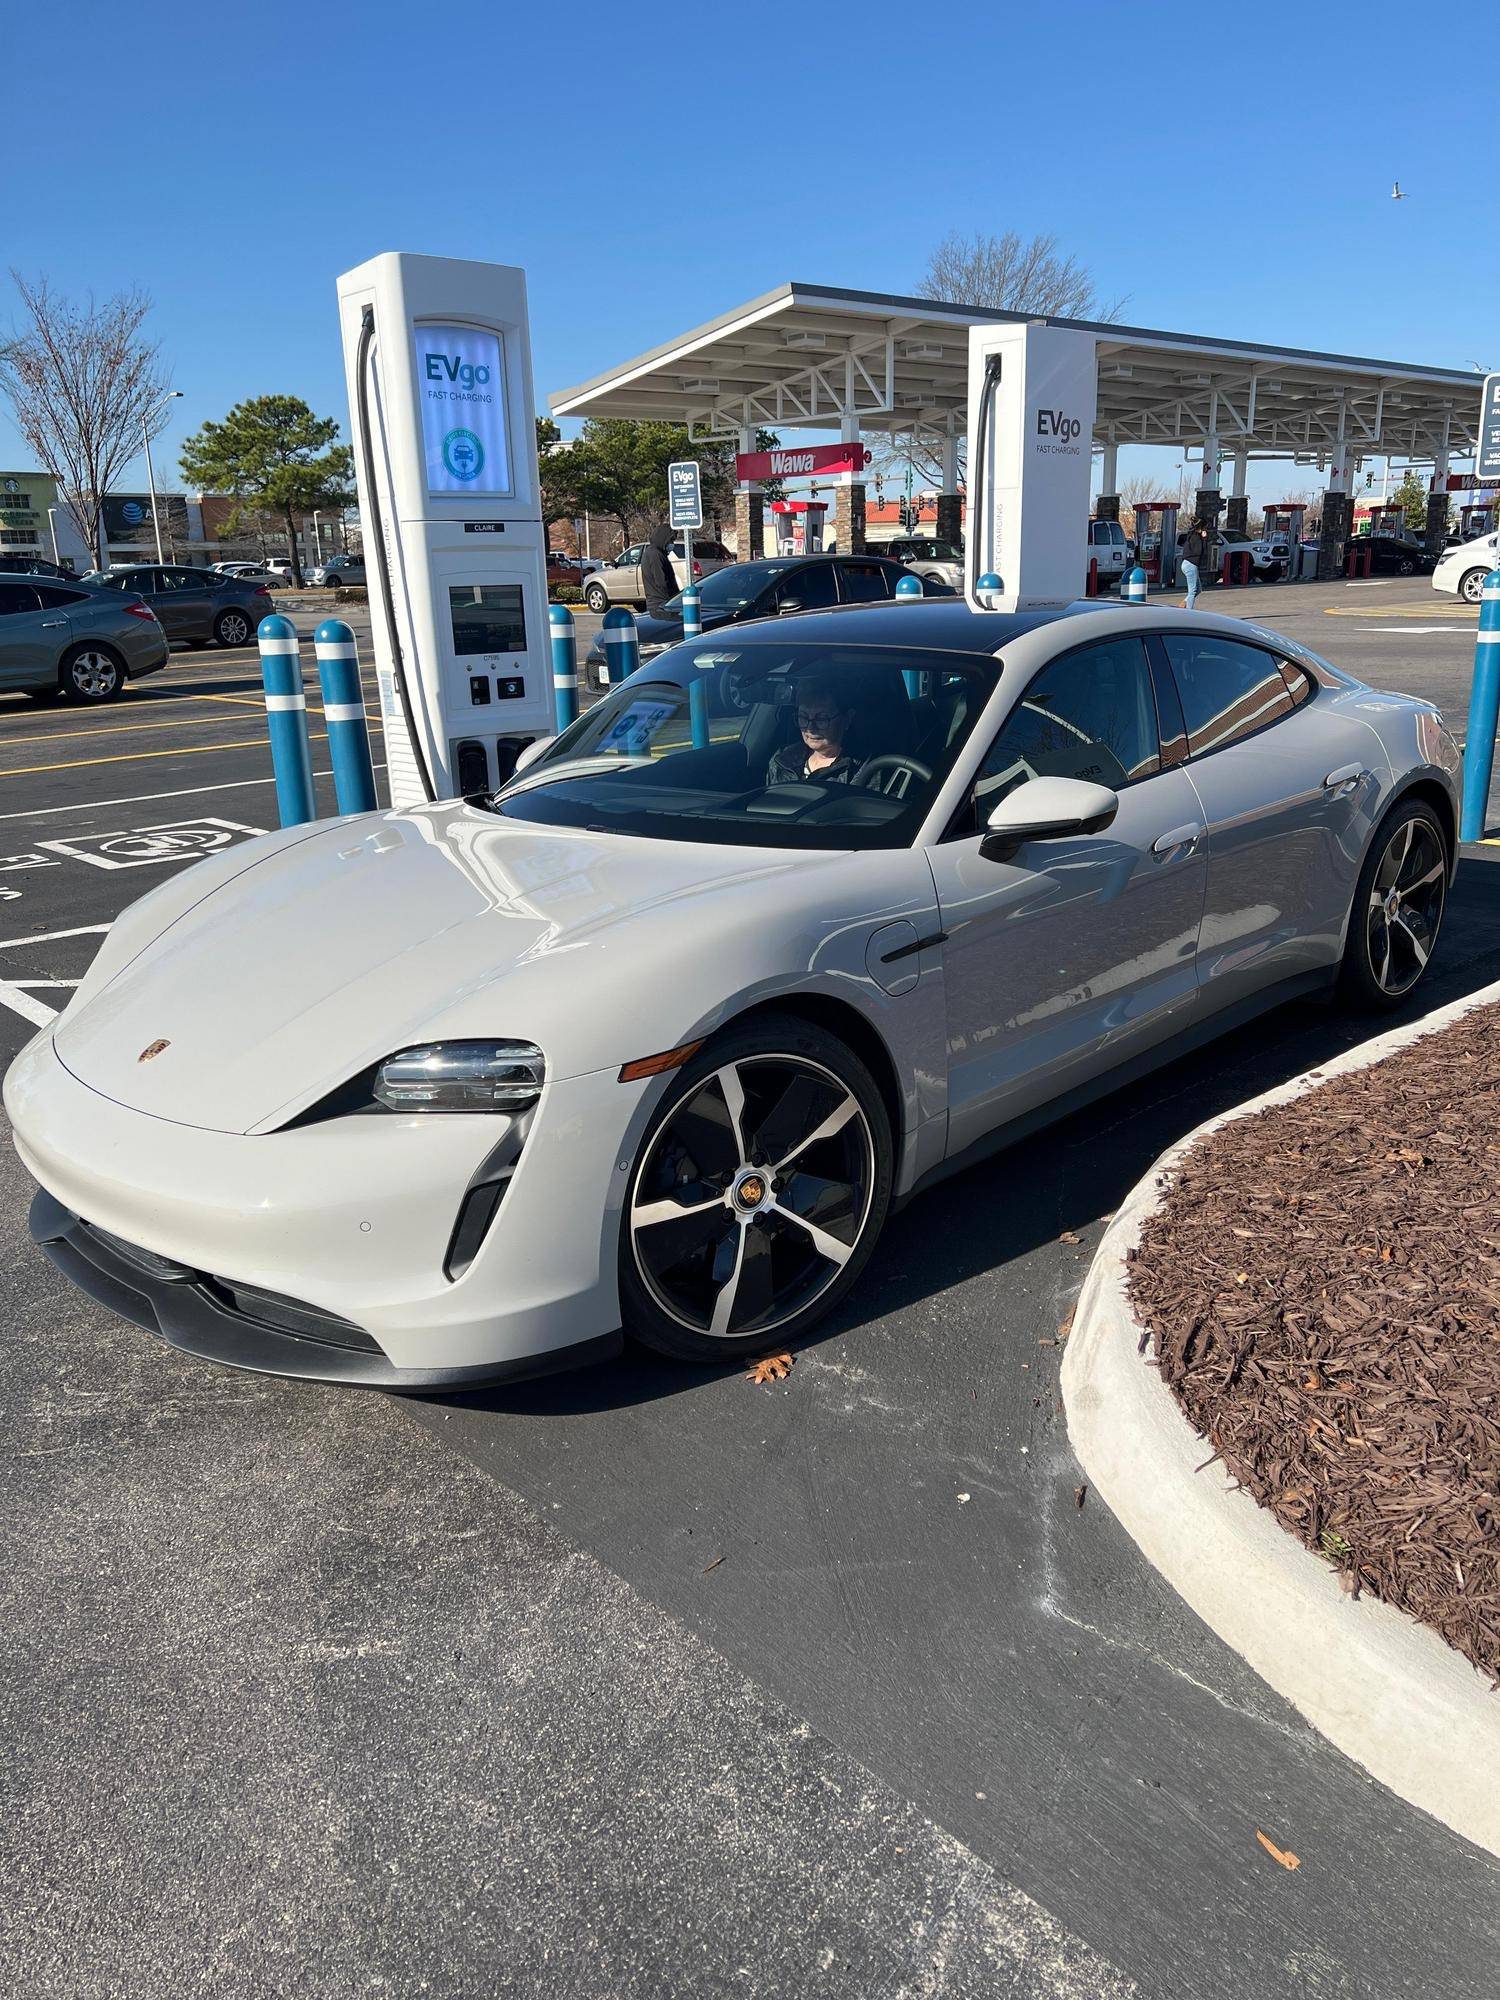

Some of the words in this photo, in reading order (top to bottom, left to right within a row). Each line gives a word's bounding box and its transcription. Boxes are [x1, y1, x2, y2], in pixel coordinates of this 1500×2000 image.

[425, 353, 490, 391] EVgo
[428, 391, 448, 400] FAST
[449, 391, 492, 403] CHARGING
[1037, 409, 1080, 444] EVgo
[866, 453, 871, 461] 2
[1036, 445, 1051, 454] FAST
[1051, 445, 1080, 456] CHARGING
[770, 453, 815, 475] Wawa
[672, 470, 694, 484] EVgo
